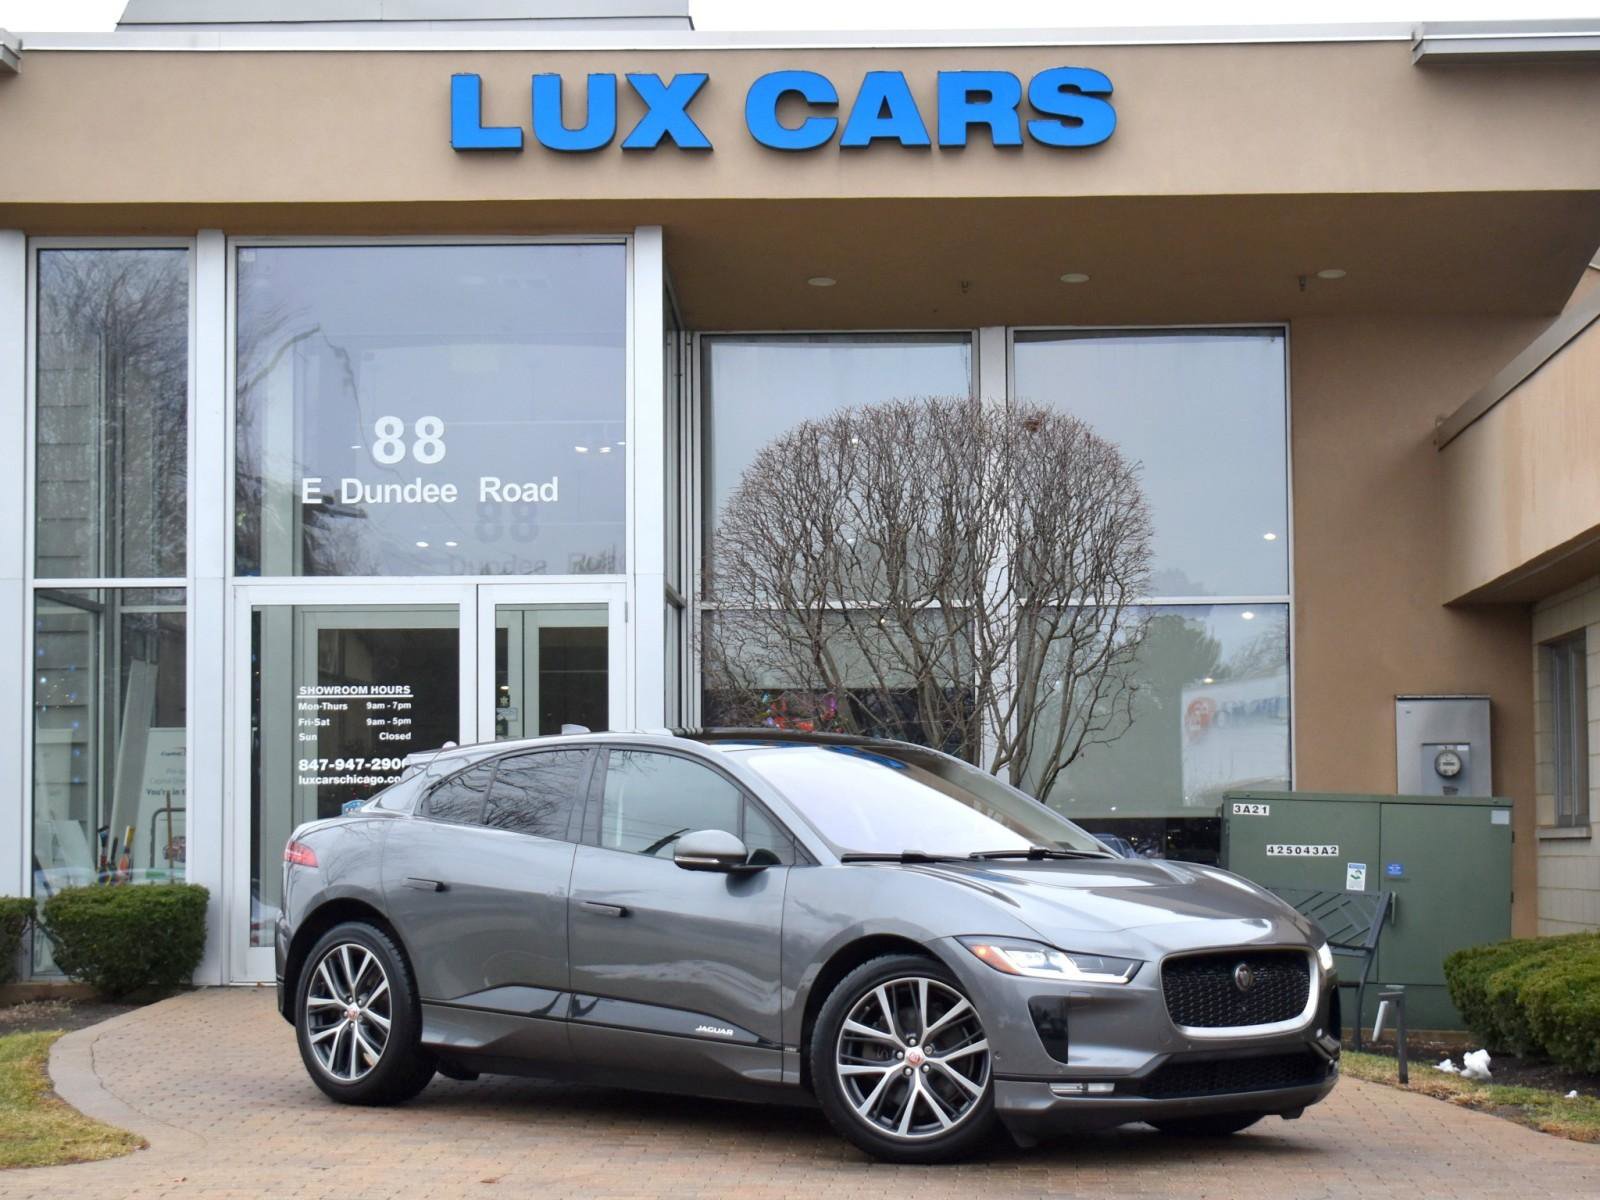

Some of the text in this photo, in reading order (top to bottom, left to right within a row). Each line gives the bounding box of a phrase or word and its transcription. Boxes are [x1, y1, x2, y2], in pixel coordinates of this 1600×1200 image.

[451, 66, 1118, 152] LUX CARS
[372, 416, 446, 464] 88
[302, 477, 559, 504] E Dundee Road
[299, 685, 411, 695] SHOWROOM HOURS
[298, 702, 348, 710] Mon-Thurs
[392, 701, 411, 710] 7pm
[298, 718, 330, 726] Fri-Sat
[392, 717, 411, 726] 5pm
[298, 732, 411, 741] Sun Closed
[299, 775, 402, 786] luxcarschicago.co
[1234, 805, 1268, 815] 3A21
[1267, 846, 1338, 855] 425043A2
[695, 1025, 734, 1036] JAGUAR
